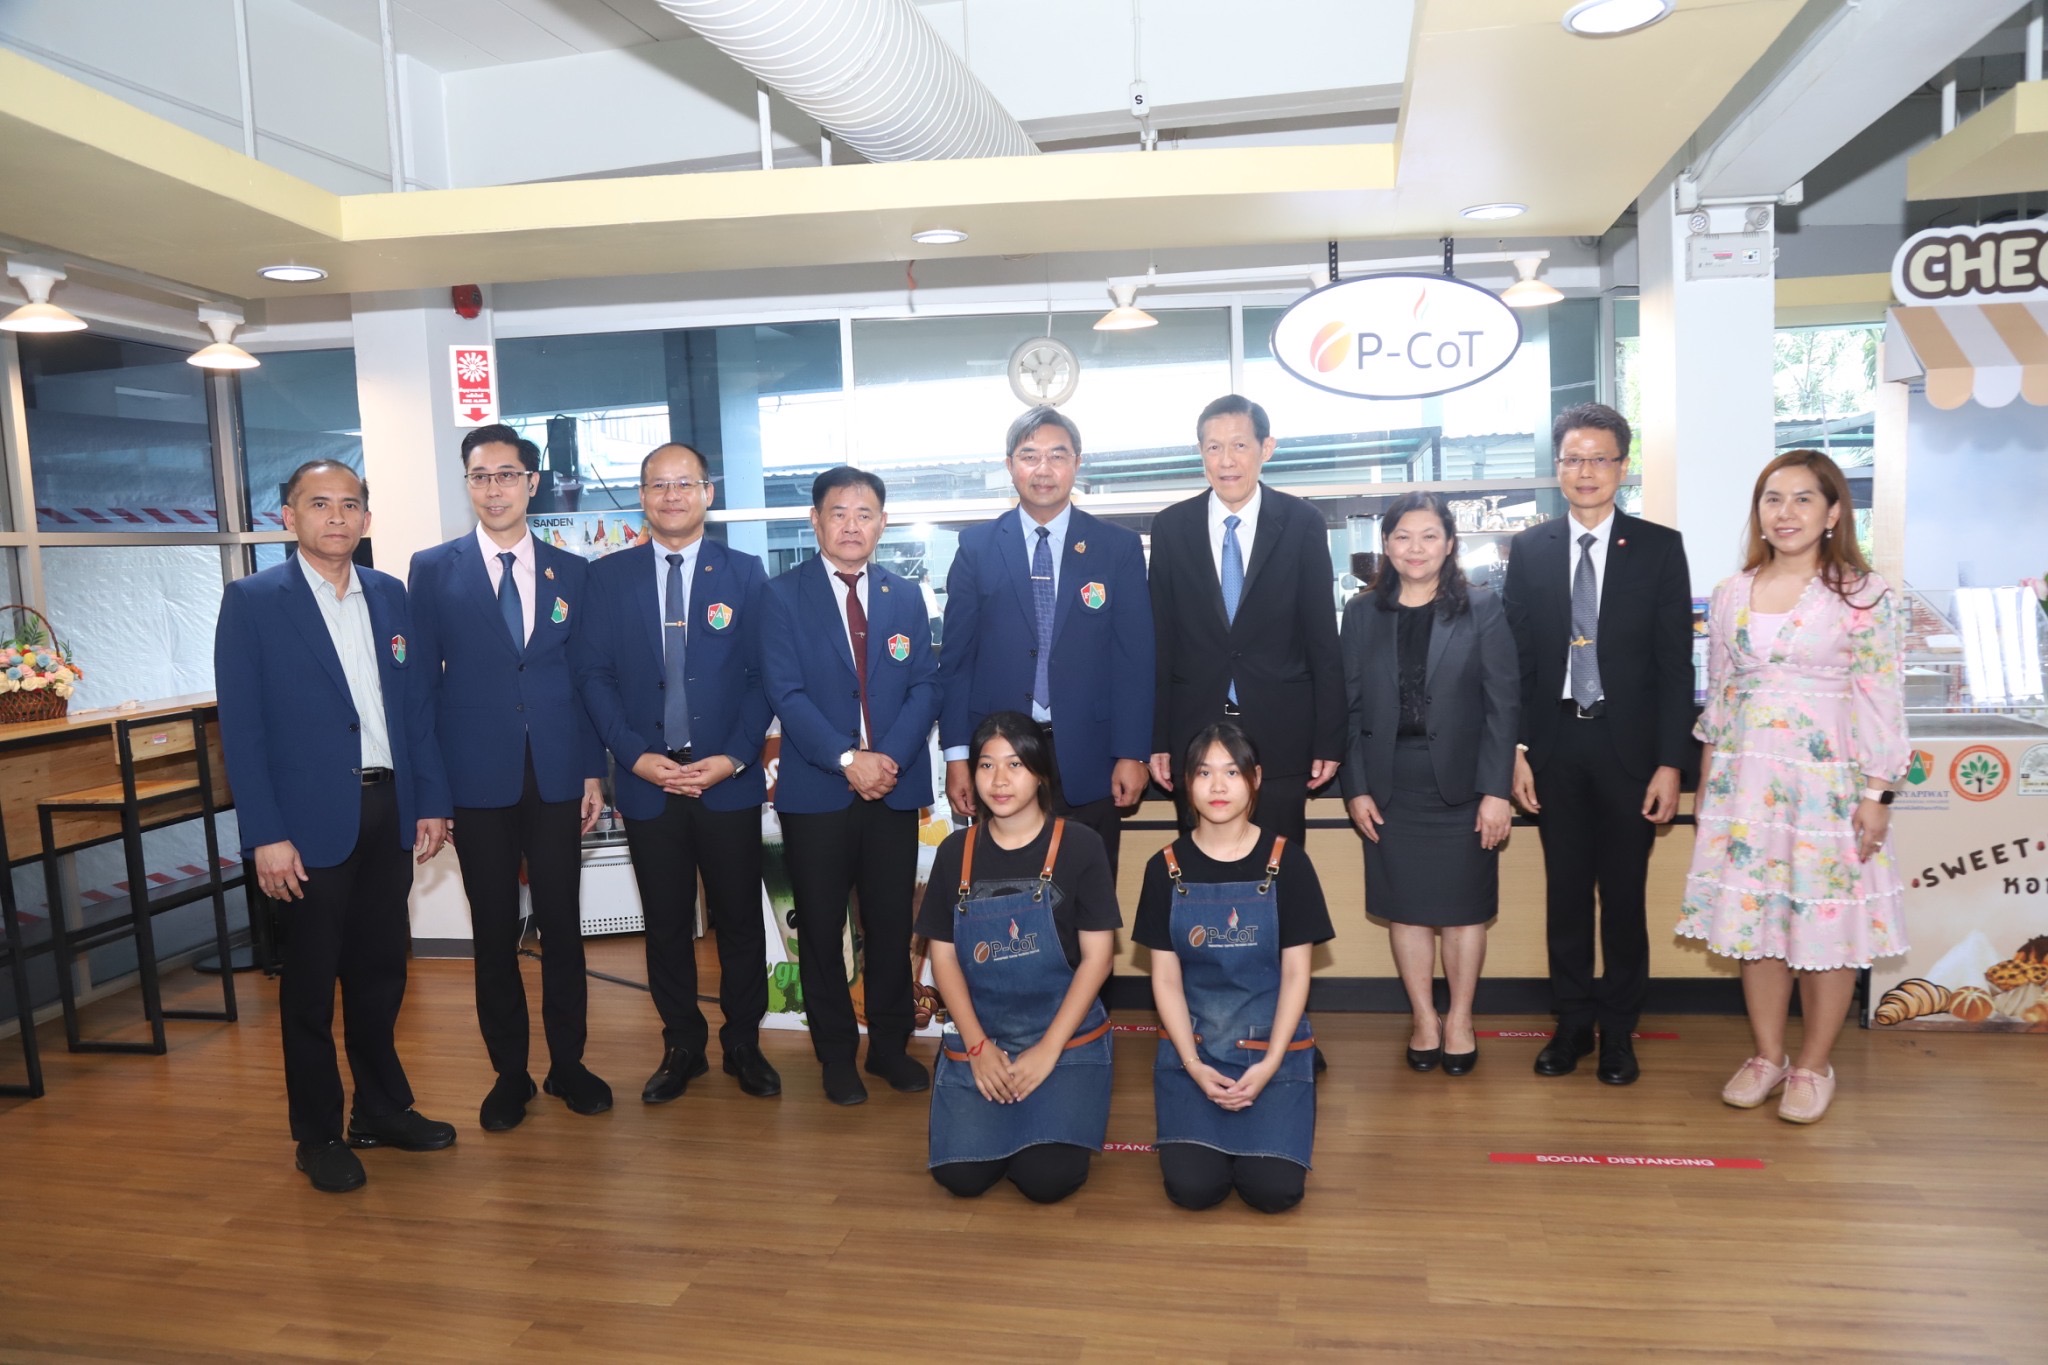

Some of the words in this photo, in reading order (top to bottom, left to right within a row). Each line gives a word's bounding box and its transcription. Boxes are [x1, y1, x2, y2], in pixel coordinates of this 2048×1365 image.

[1134, 94, 1143, 105] S
[1908, 236, 2048, 294] CHE
[1358, 330, 1484, 370] P-CoT
[533, 517, 574, 528] SANDEN
[1921, 837, 2030, 888] SWEET
[2003, 877, 2048, 895] หอ
[1207, 925, 1258, 943] P-CoT
[990, 932, 1038, 958] P-CoT
[1536, 1154, 1600, 1163] SOCIAL
[1607, 1156, 1715, 1166] DISTANCING
